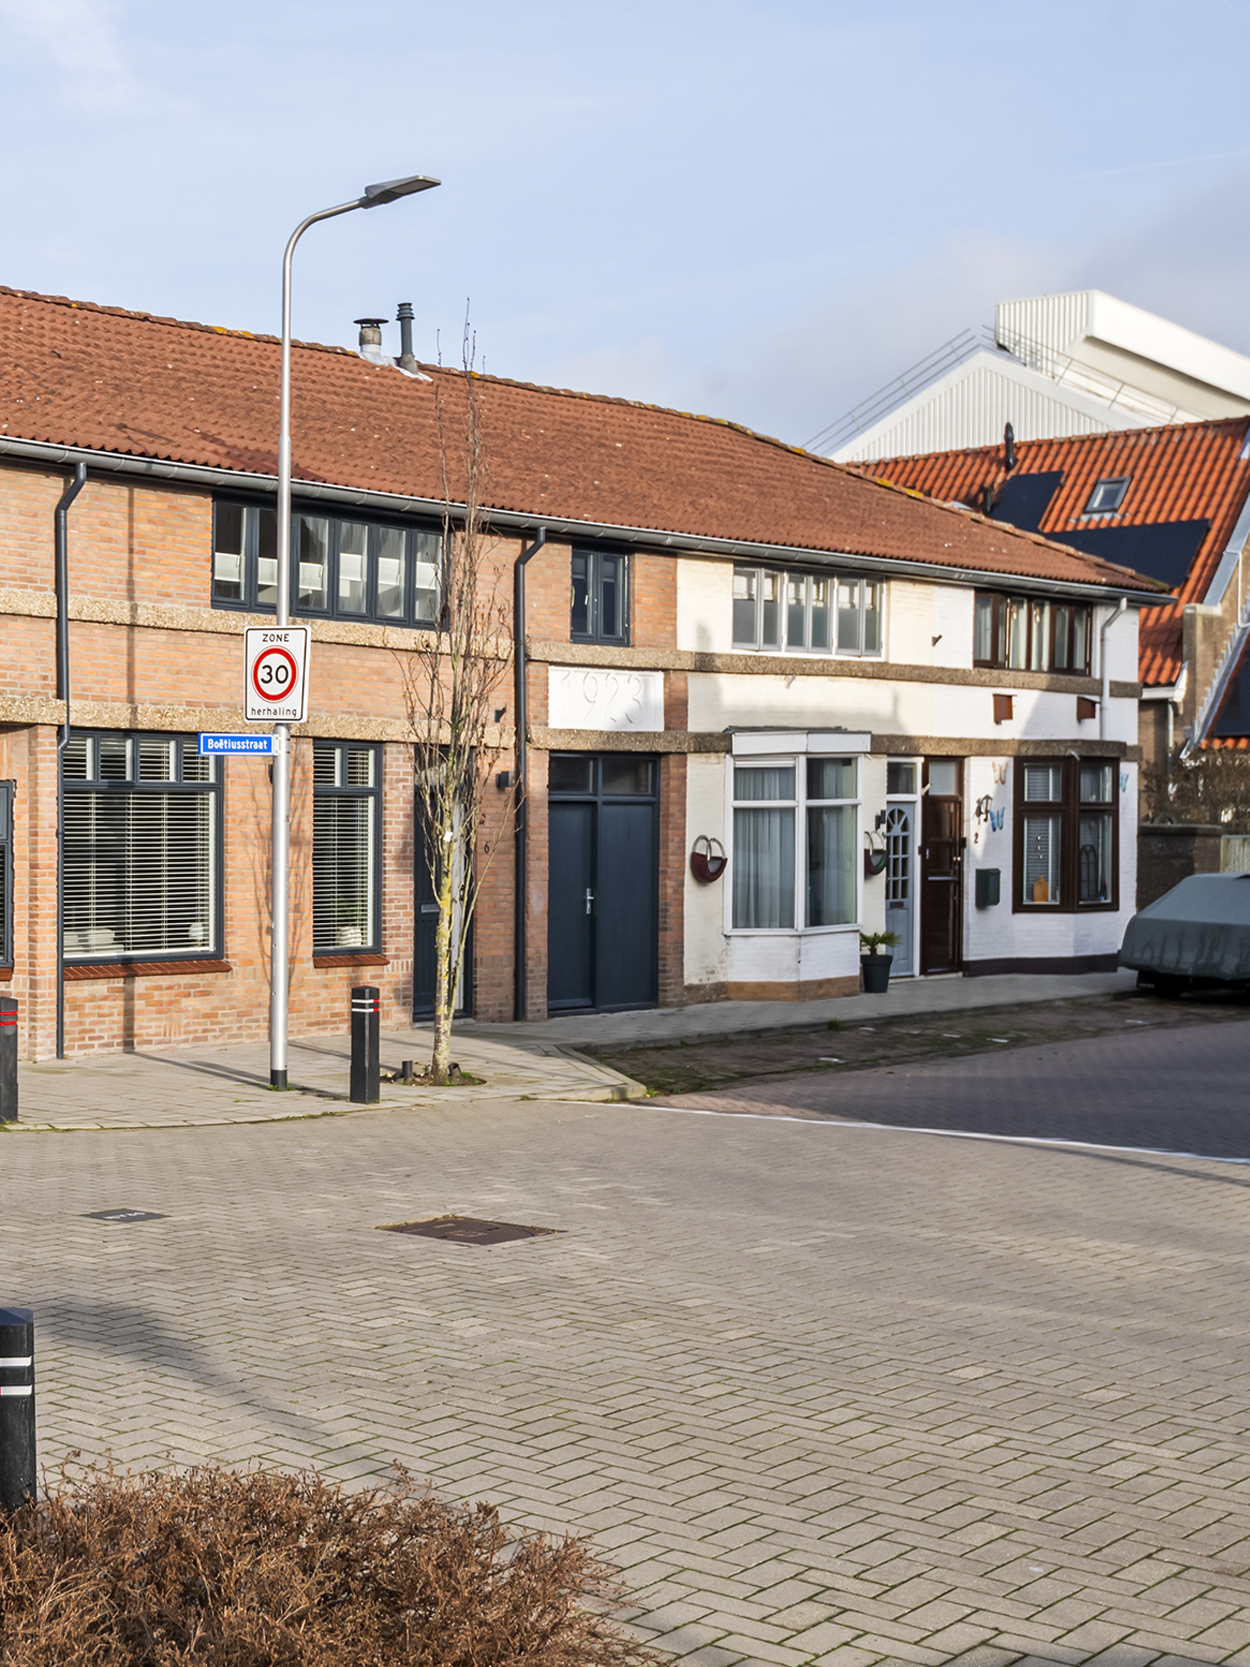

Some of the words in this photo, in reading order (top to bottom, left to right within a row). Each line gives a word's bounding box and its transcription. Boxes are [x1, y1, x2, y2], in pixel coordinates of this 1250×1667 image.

[262, 633, 290, 643] ZONE
[260, 664, 289, 684] 30
[559, 671, 643, 724] 1923
[250, 706, 298, 718] herhaling
[207, 738, 268, 750] Boëtiusstraat
[973, 832, 979, 845] 2
[484, 841, 490, 854] 6
